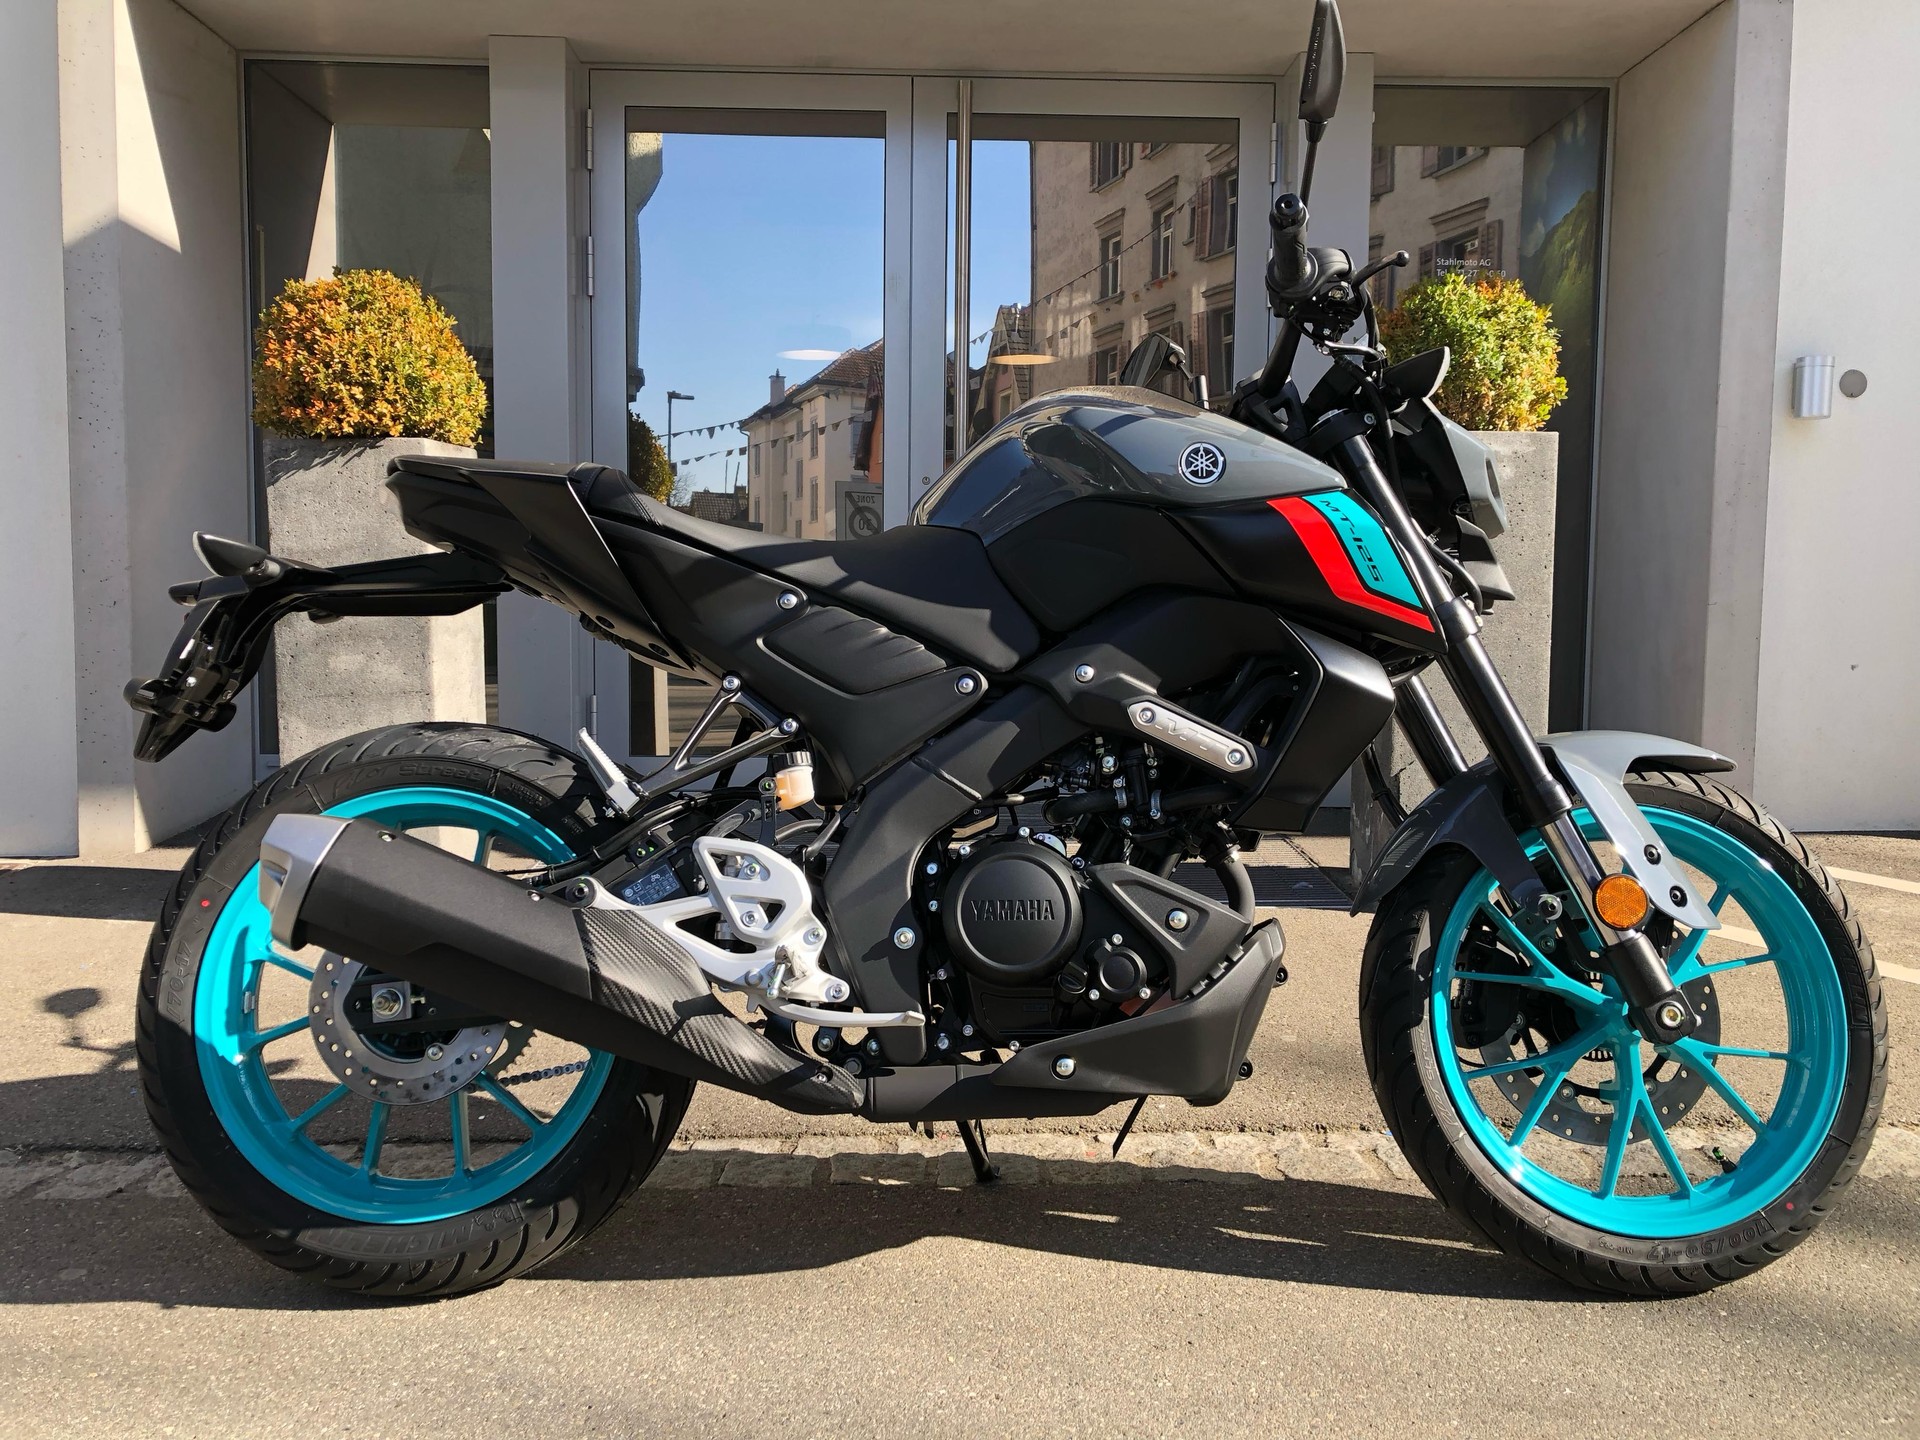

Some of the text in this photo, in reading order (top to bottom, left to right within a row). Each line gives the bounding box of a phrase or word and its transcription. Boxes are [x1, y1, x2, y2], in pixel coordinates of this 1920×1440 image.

[1436, 257, 1491, 266] Stahlmoto AG
[1319, 500, 1385, 583] MT-125
[1154, 717, 1230, 751] MT
[399, 761, 483, 783] Street
[970, 899, 1056, 922] YAMAHA
[308, 1223, 475, 1255] MICHELIN
